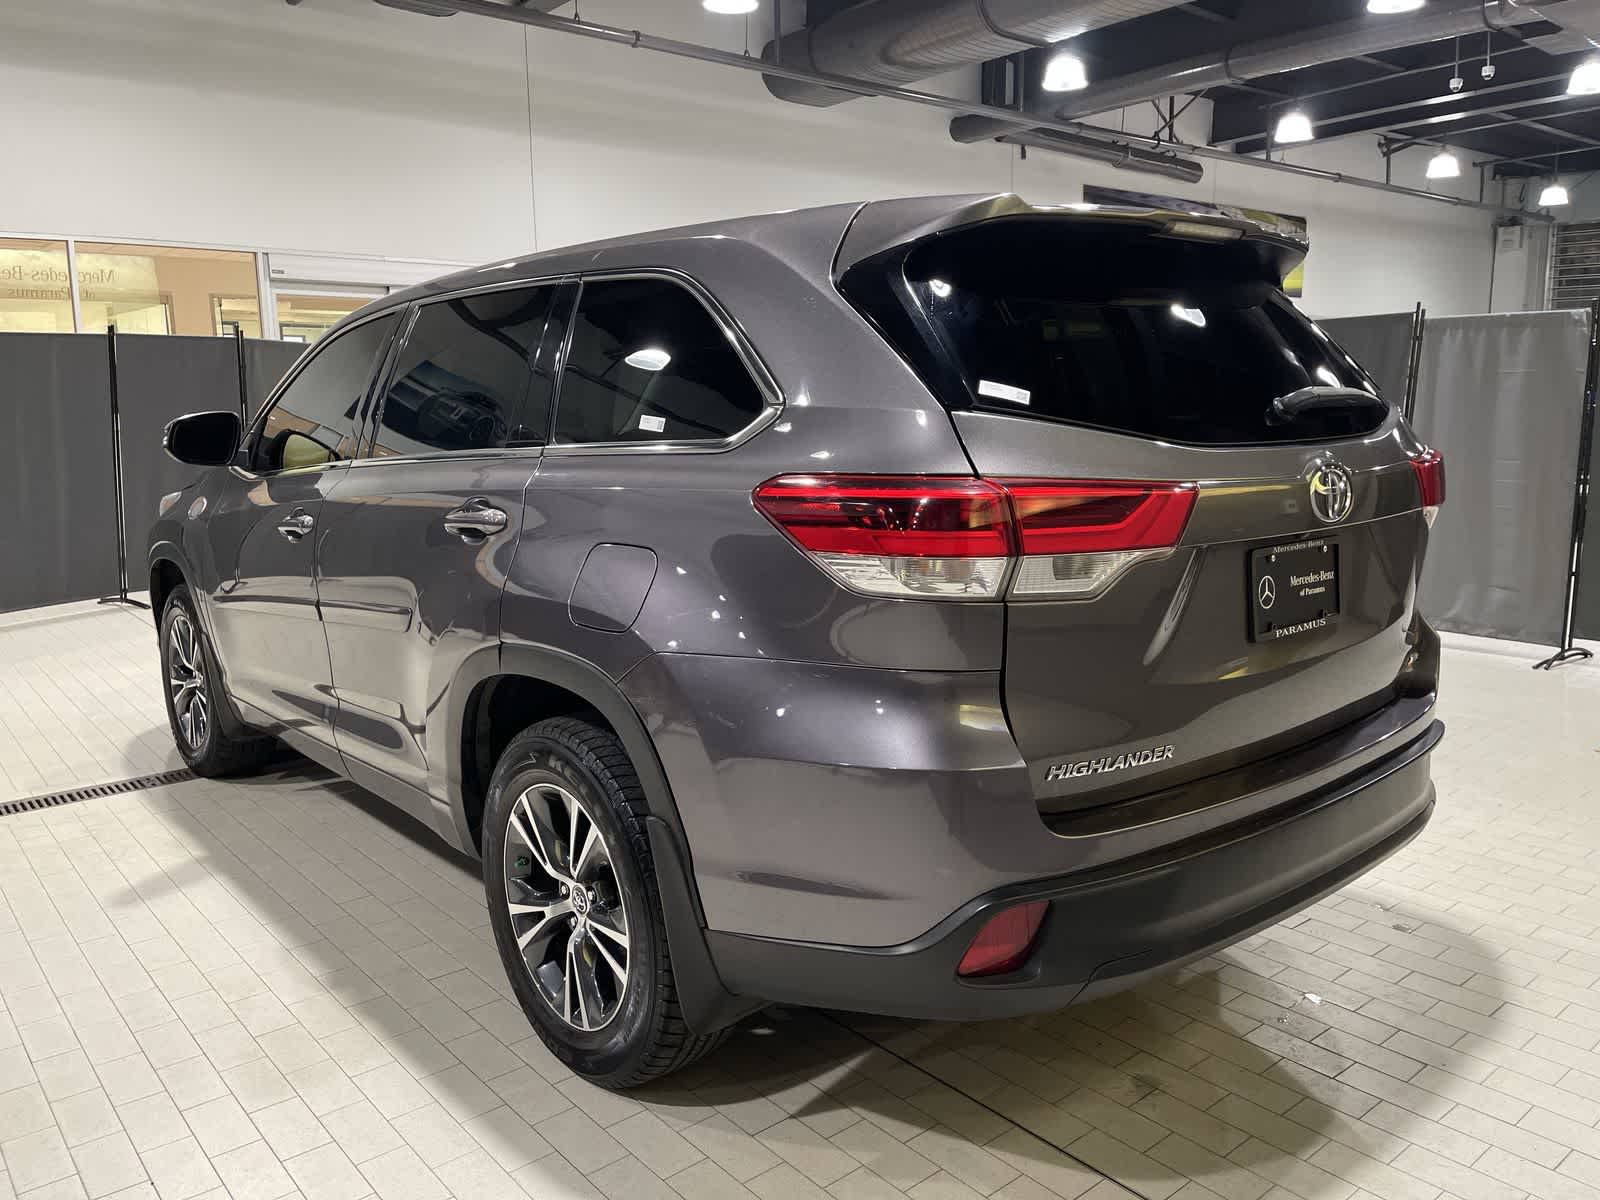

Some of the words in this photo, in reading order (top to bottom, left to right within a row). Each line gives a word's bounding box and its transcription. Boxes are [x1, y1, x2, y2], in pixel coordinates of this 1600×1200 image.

[1273, 540, 1325, 554] Mercedes-Benz
[1290, 570, 1335, 587] Mercedes-Benz
[1299, 588, 1306, 597] of
[1305, 586, 1327, 596] Paramus
[1275, 618, 1327, 638] PARAMUS
[1045, 744, 1177, 781] HIGHLANDER
